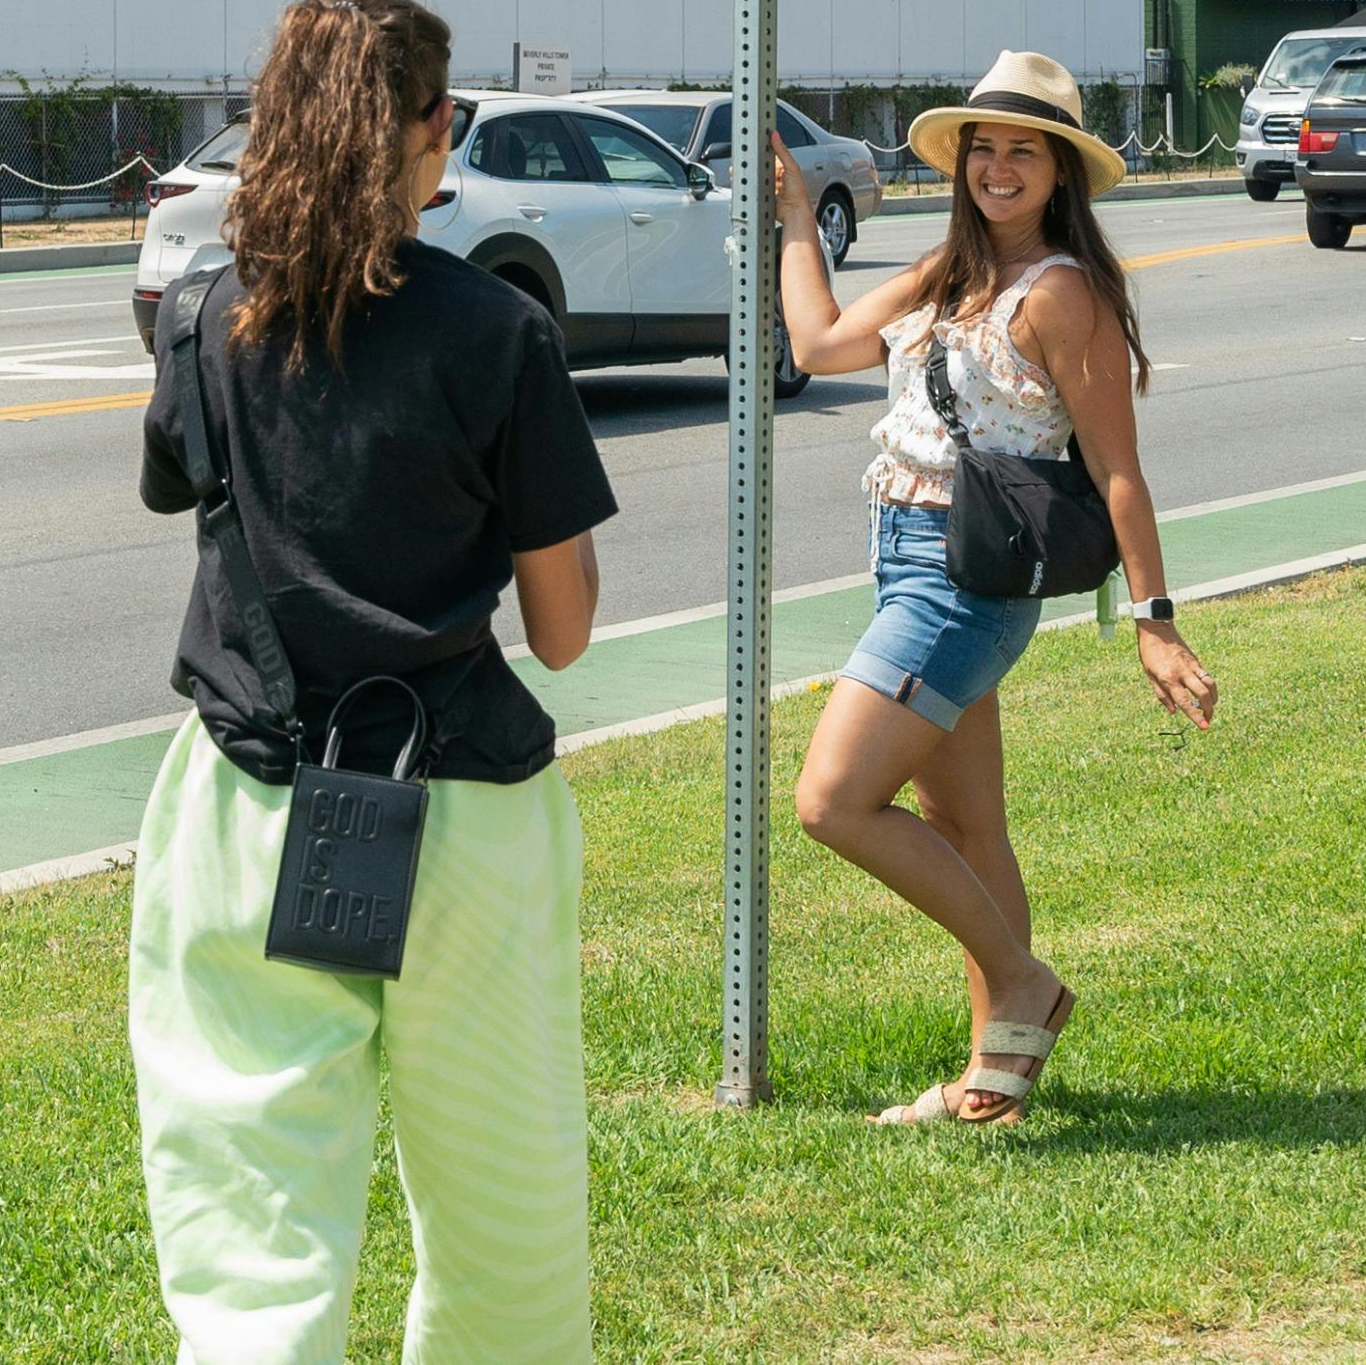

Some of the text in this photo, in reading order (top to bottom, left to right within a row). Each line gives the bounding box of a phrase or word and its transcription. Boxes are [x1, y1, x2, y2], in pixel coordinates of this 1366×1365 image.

[1028, 561, 1043, 595] adidas
[309, 788, 381, 843] GOD
[300, 835, 338, 884] IS
